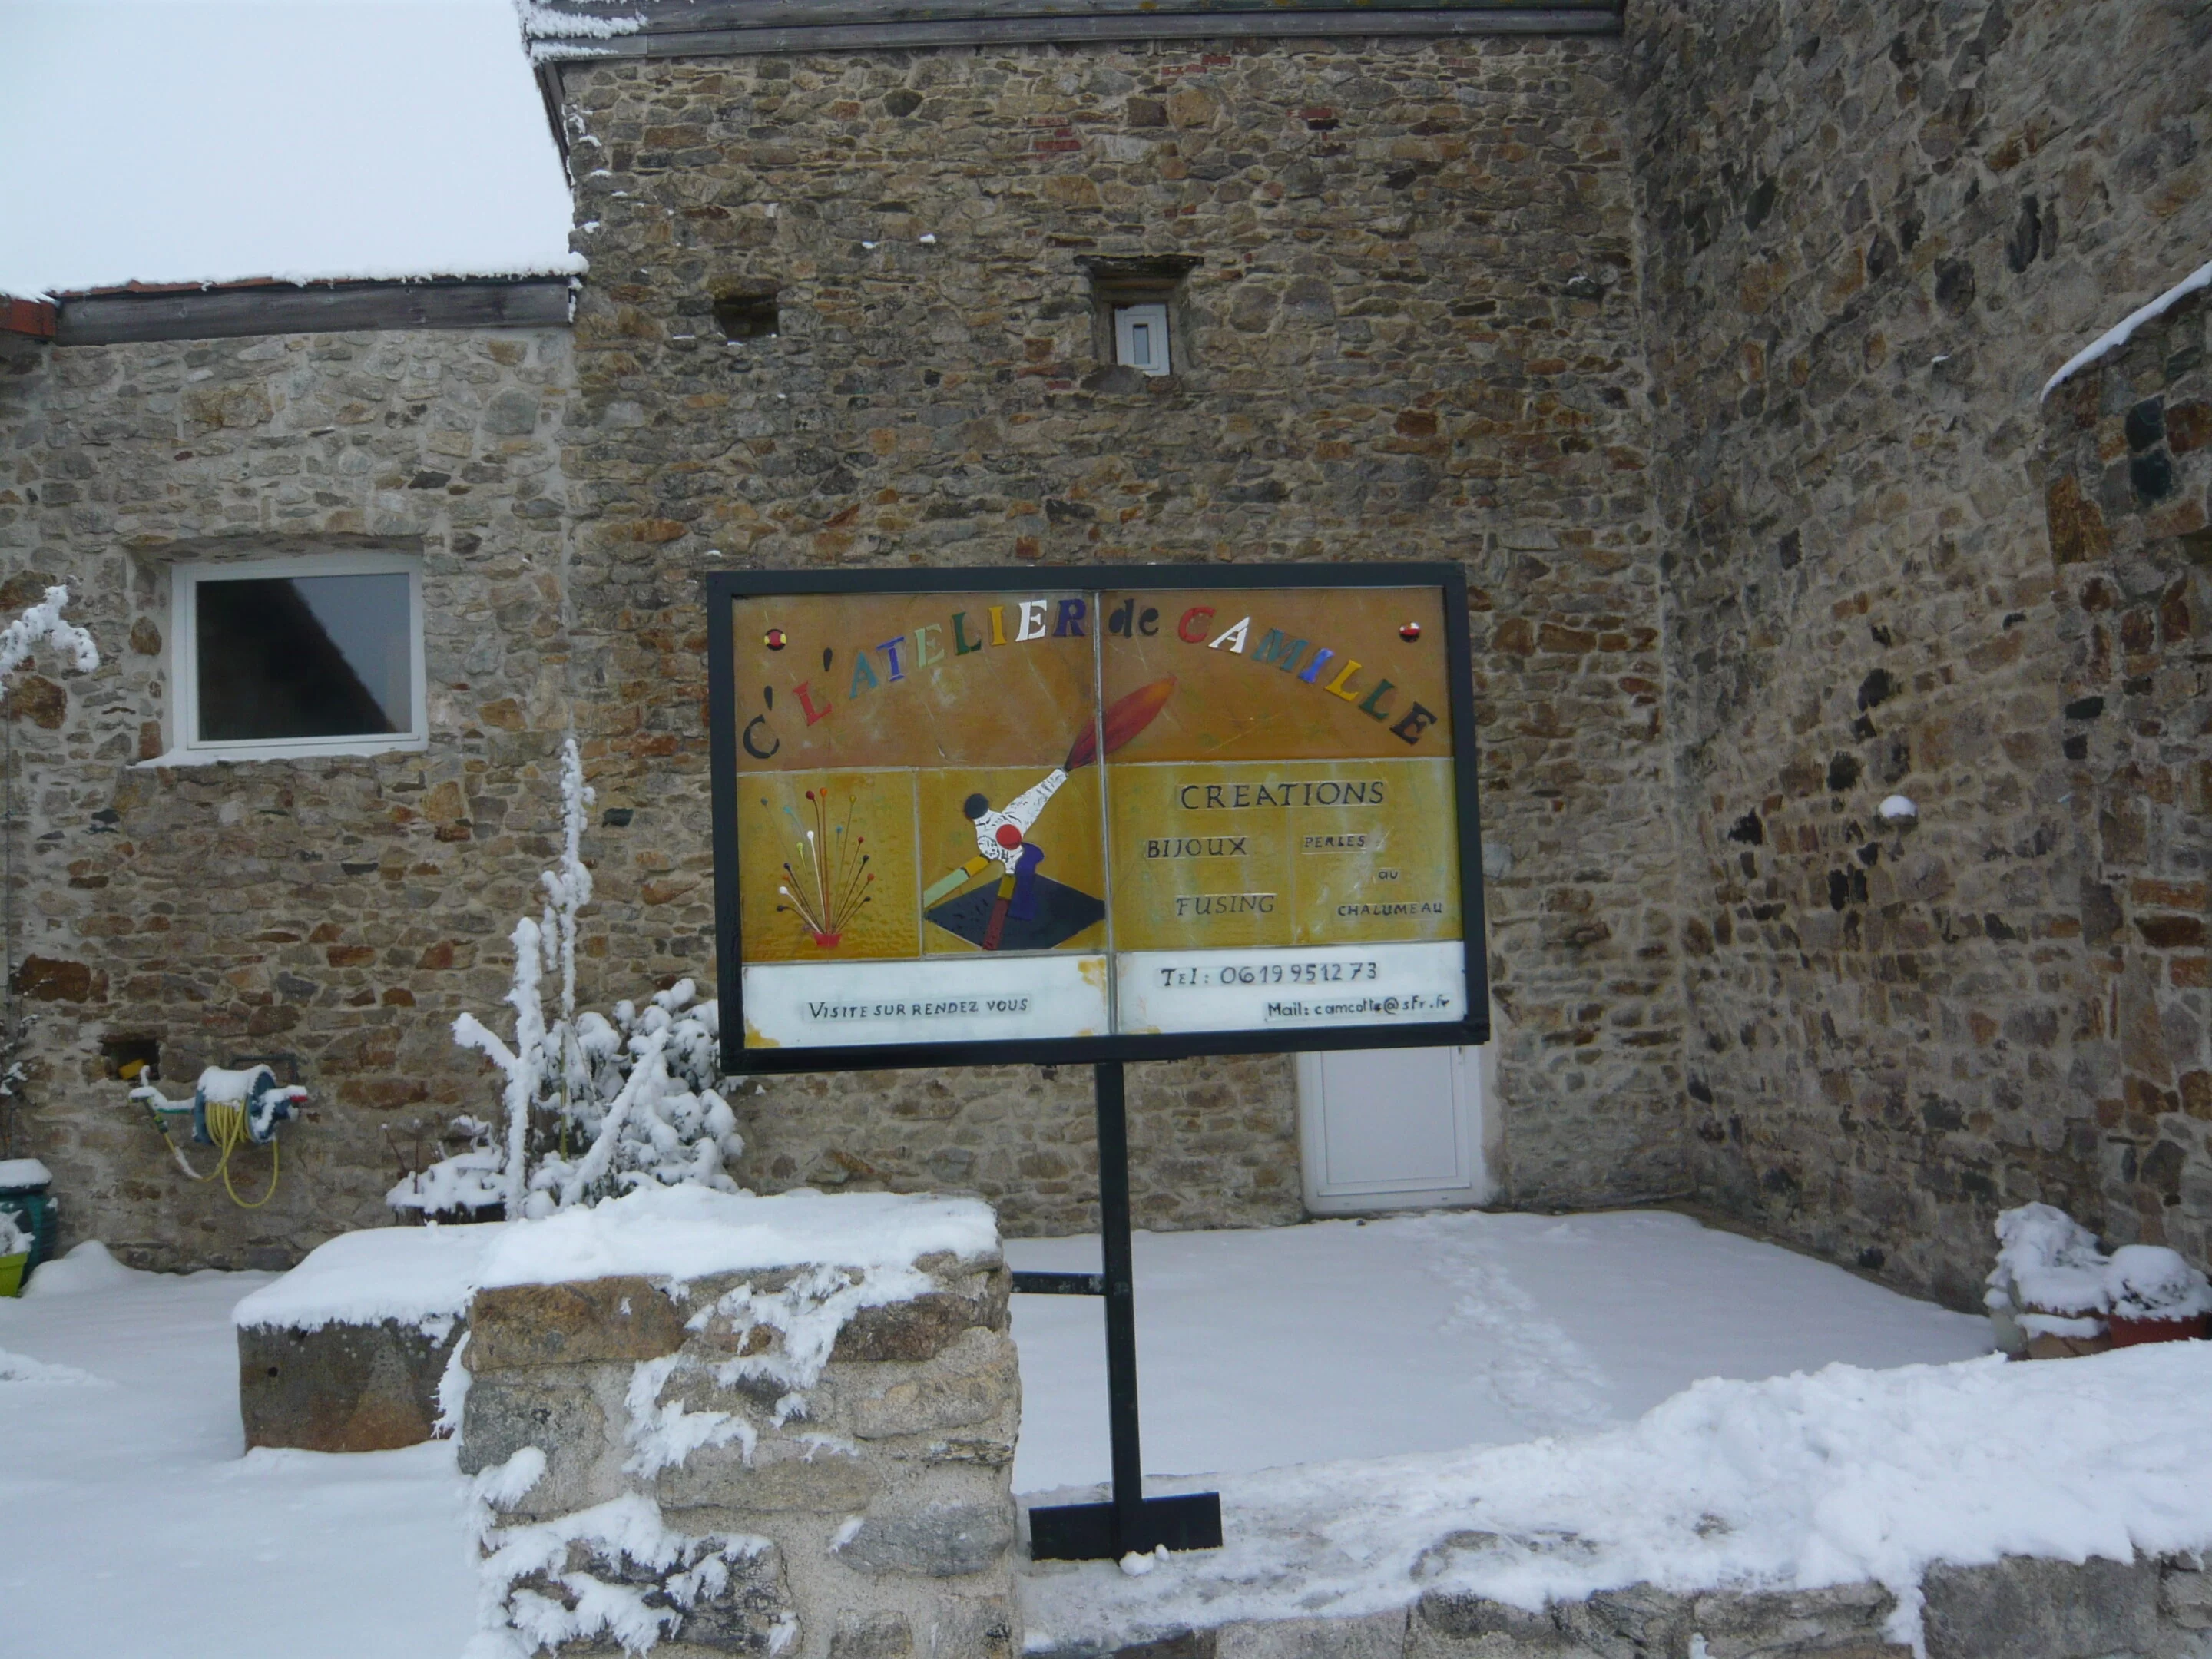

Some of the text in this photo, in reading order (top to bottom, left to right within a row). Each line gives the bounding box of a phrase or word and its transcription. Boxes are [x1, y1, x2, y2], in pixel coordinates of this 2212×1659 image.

[1108, 598, 1159, 638] de
[1177, 607, 1439, 746] CAMILLE
[1181, 780, 1385, 810] CREATIONS
[1147, 836, 1247, 859] BIJOUX
[1304, 835, 1366, 848] PERLES
[1378, 869, 1399, 880] au
[1175, 895, 1275, 916] FUSING
[1337, 902, 1443, 917] CHALUMEAU
[873, 1004, 906, 1016] SUR
[912, 1000, 979, 1016] RENDEZ
[986, 998, 1028, 1012] VOUS
[1268, 1001, 1310, 1017] Mail:
